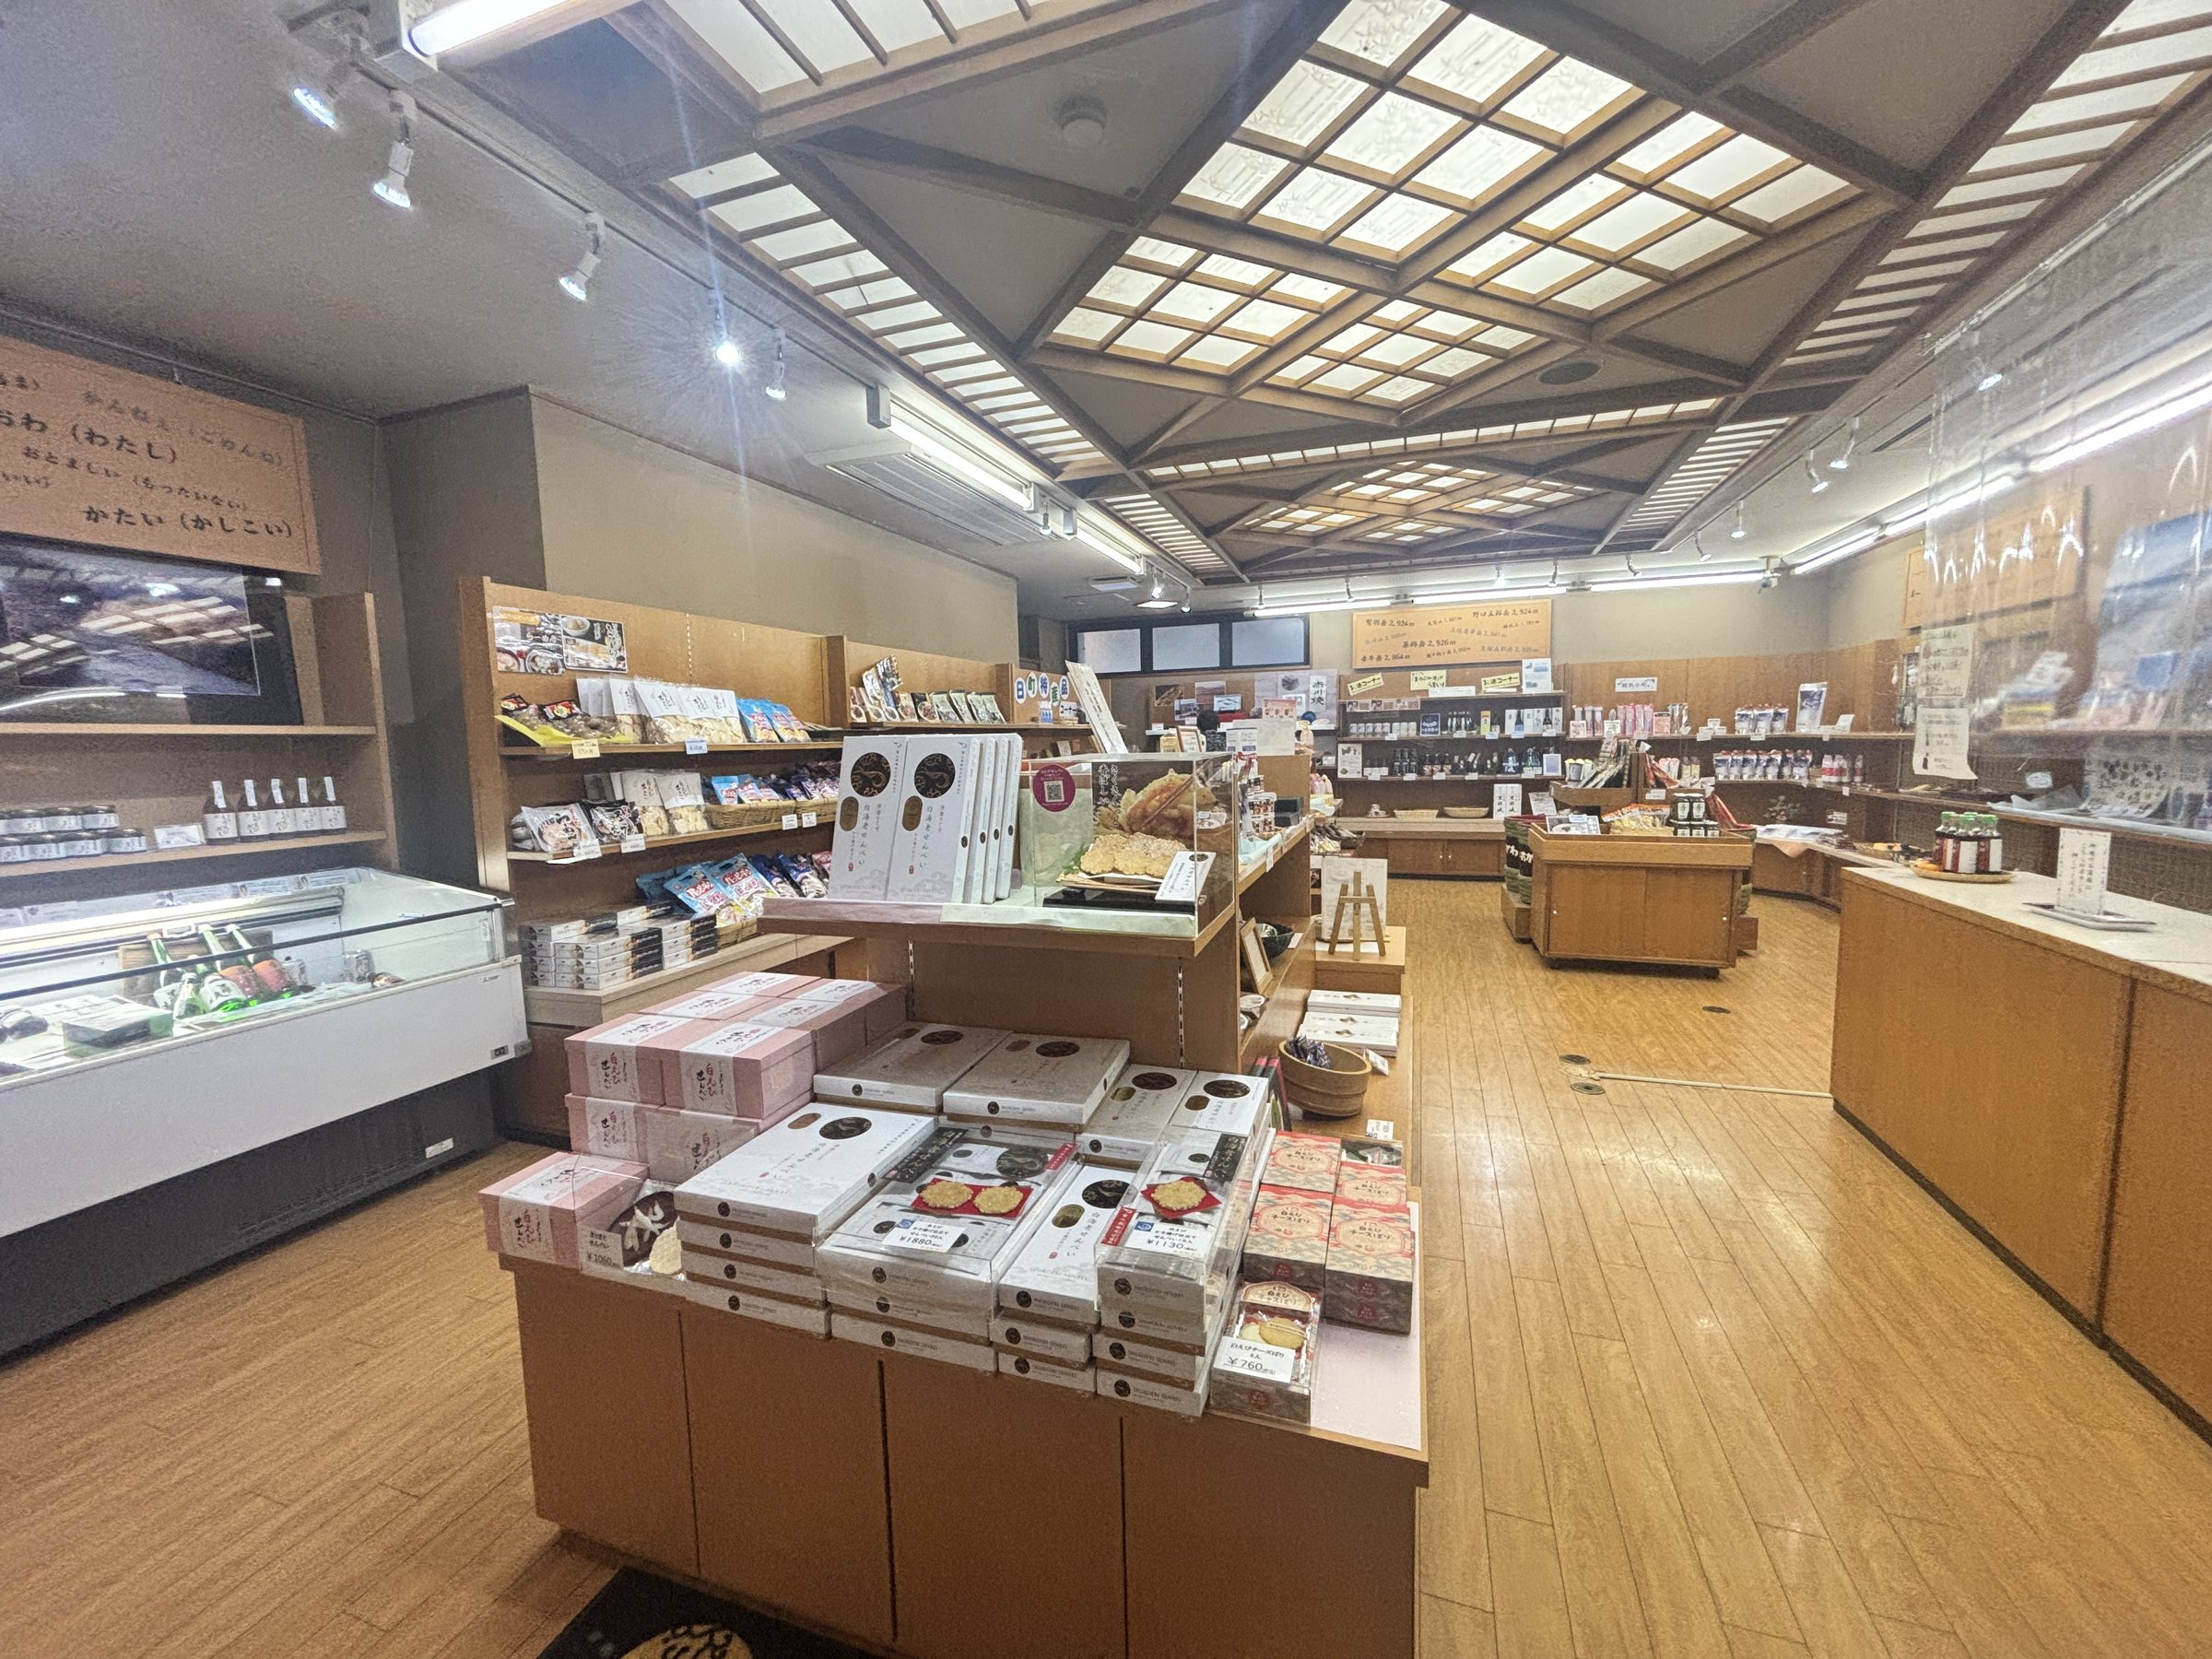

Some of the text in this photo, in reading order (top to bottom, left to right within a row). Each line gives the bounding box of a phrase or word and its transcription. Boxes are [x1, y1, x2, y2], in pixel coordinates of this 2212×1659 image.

[77, 505, 292, 538] かたい（かしこい）
[1147, 1239, 1184, 1250] ¥1130
[1228, 1356, 1264, 1371] ¥760
